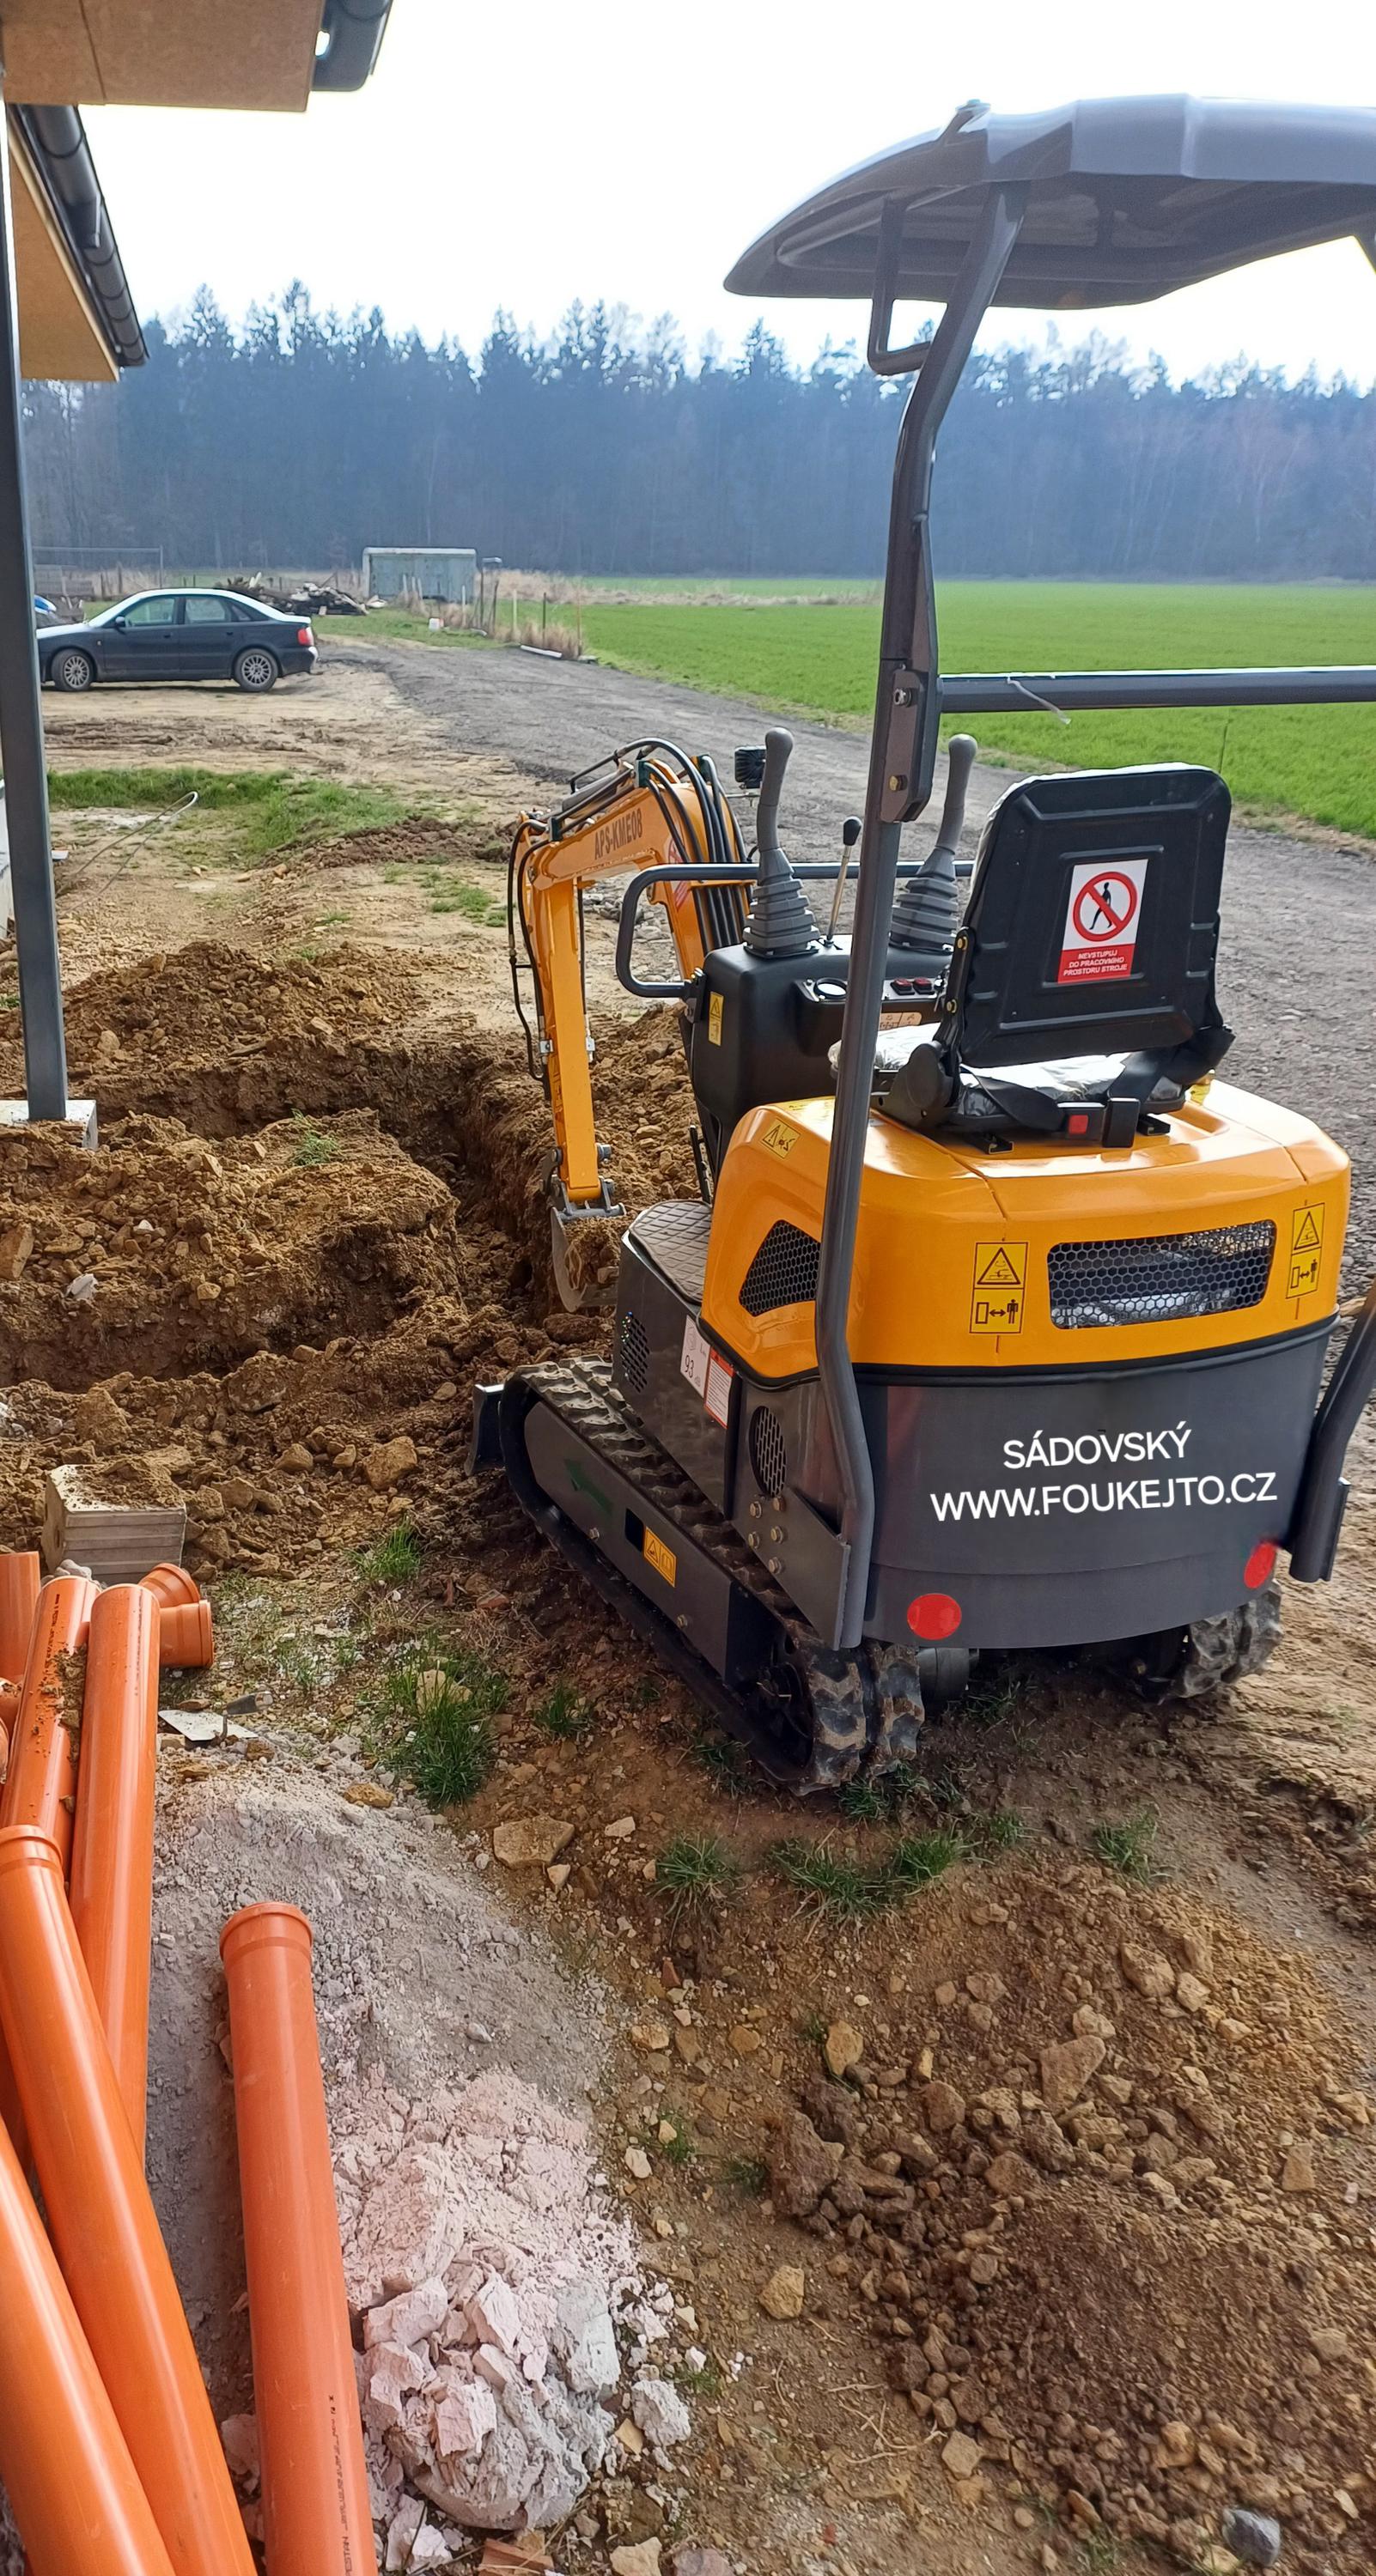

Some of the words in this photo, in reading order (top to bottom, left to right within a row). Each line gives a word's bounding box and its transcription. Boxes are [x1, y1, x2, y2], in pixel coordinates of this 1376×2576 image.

[594, 808, 642, 860] APS-KME08
[1062, 967, 1100, 976] PROSTORU
[1101, 963, 1127, 973] STROJE
[1078, 950, 1117, 959] NEVSTUPUJ
[685, 1354, 695, 1378] 93
[1003, 1420, 1192, 1469] SÁDOVSKÝ
[930, 1472, 1278, 1522] WWW.FOUKEJTO.CZ
